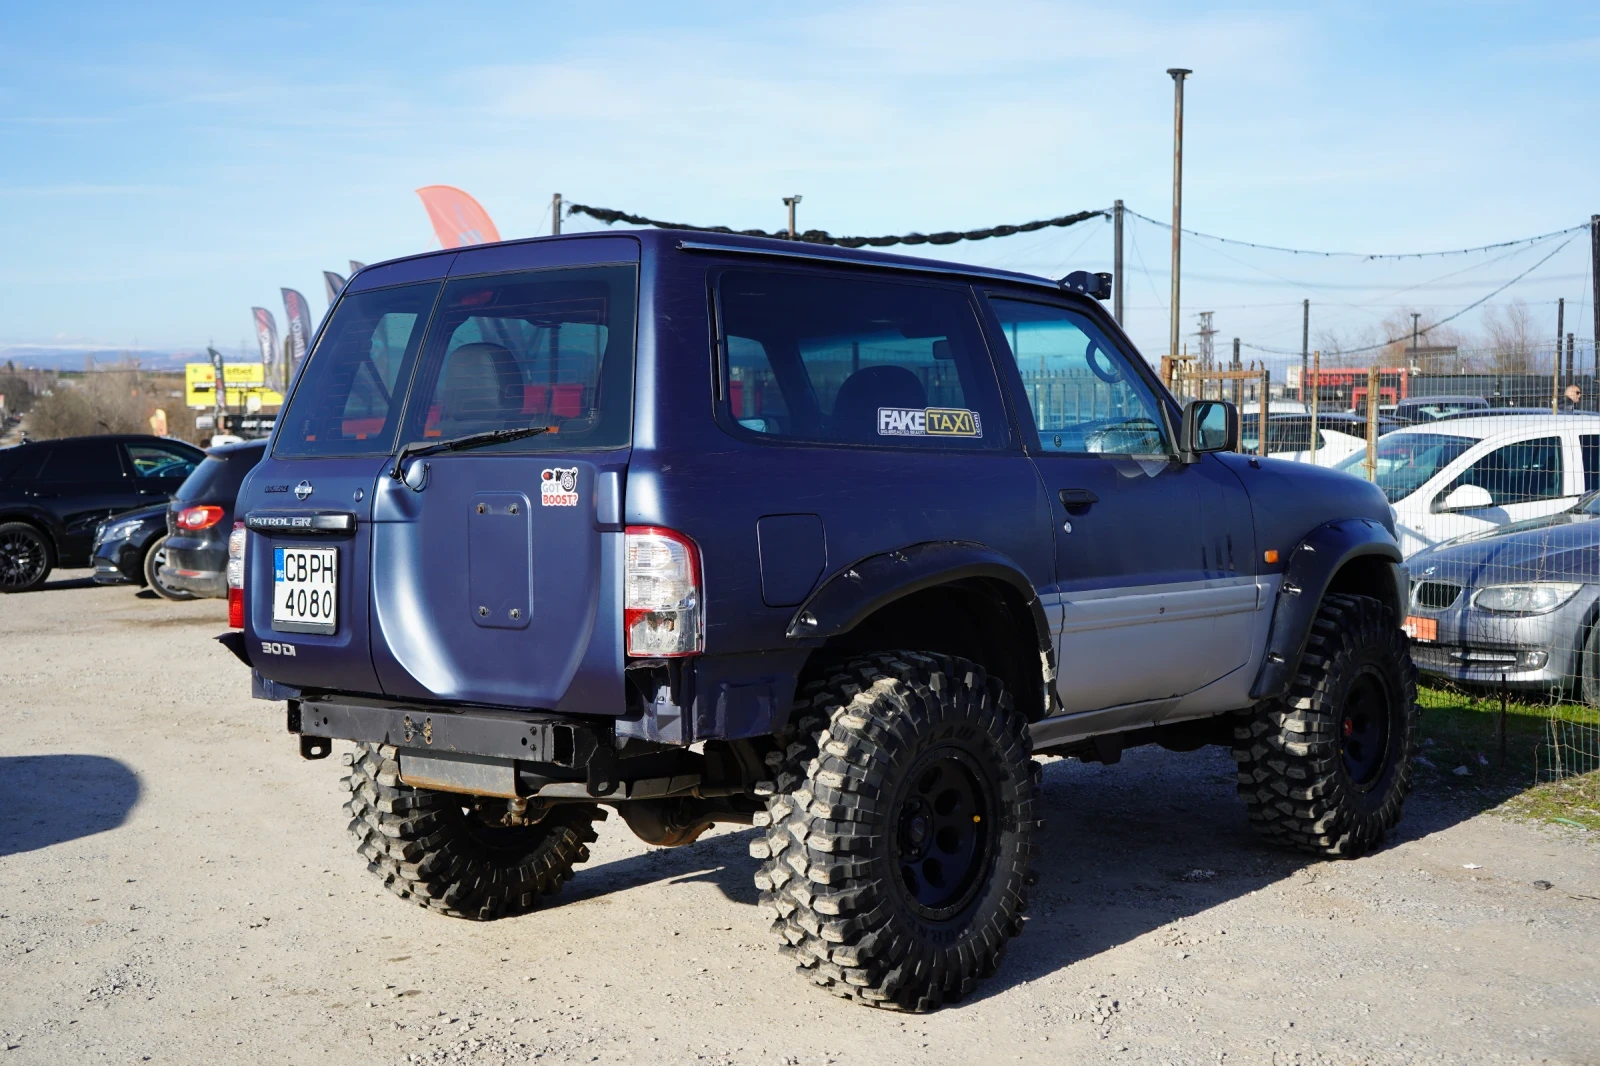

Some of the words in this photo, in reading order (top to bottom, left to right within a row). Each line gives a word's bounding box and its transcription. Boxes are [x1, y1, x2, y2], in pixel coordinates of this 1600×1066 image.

[880, 410, 926, 431] FAKE
[929, 412, 971, 434] TAXI
[542, 483, 560, 493] GOT
[542, 494, 577, 505] BOOST?
[249, 517, 291, 526] PATROL
[292, 517, 311, 527] GR
[285, 553, 334, 583] CBPH
[285, 588, 332, 619] 4080
